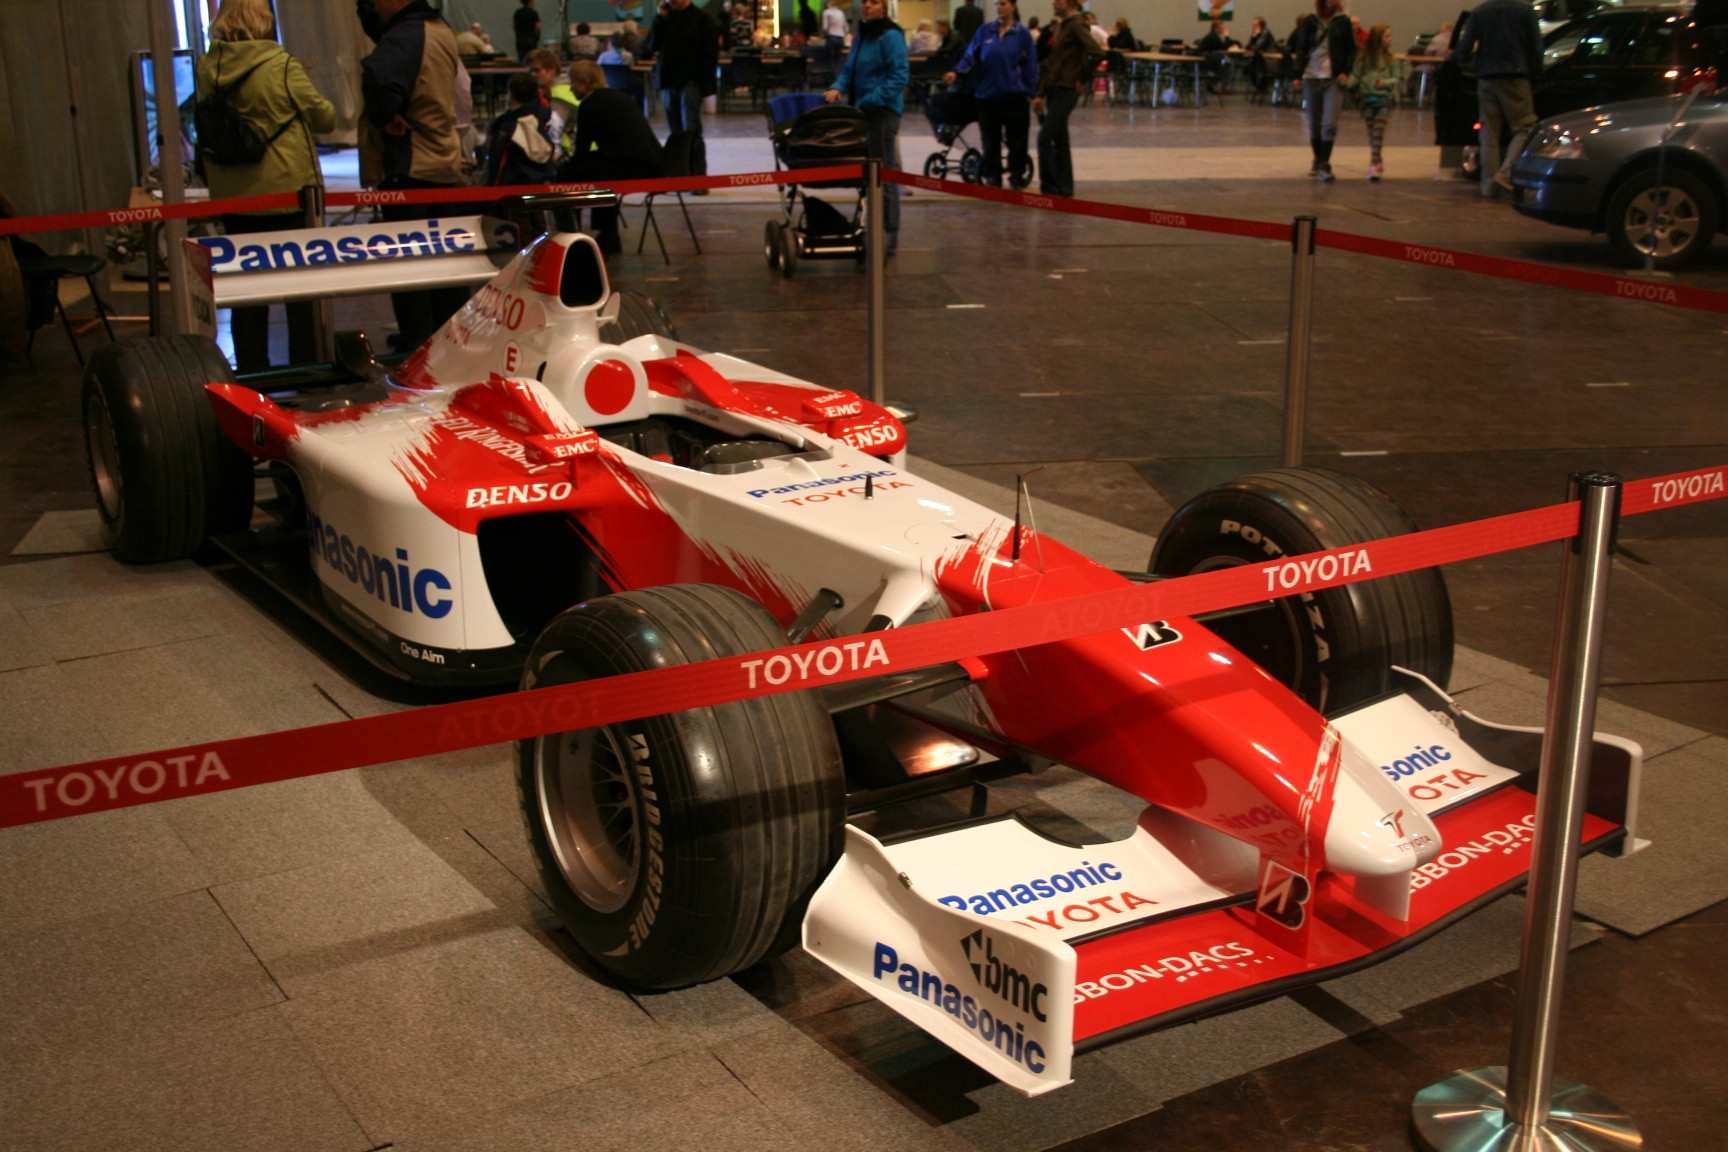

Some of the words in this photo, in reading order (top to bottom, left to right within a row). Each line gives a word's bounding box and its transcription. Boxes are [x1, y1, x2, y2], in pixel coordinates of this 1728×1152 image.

[729, 174, 773, 185] TOYOTA
[355, 191, 406, 203] TOYOTA
[108, 208, 162, 223] TOYOTA
[1150, 212, 1186, 226] TOYOTA
[198, 221, 475, 272] Panasonic
[1404, 246, 1455, 266] TOYOTA
[1615, 280, 1677, 302] TOYOTA
[505, 346, 518, 372] E
[838, 425, 898, 448] ENSO
[466, 482, 572, 509] DENSO
[746, 469, 897, 499] Panasonic
[781, 479, 912, 507] TOYOTA
[1652, 472, 1724, 504] TOYOTA
[1263, 549, 1372, 592] TOYOTA
[400, 642, 420, 658] One
[421, 650, 445, 664] Aim
[740, 638, 890, 689] TOYOTA
[23, 751, 230, 812] TOYOTA
[1410, 814, 1537, 894] BBON-DAC
[937, 860, 1122, 916] Panasonic
[1011, 891, 1159, 930] YOTA
[985, 936, 1047, 1023] bmc
[873, 942, 1046, 1074] Panasonic
